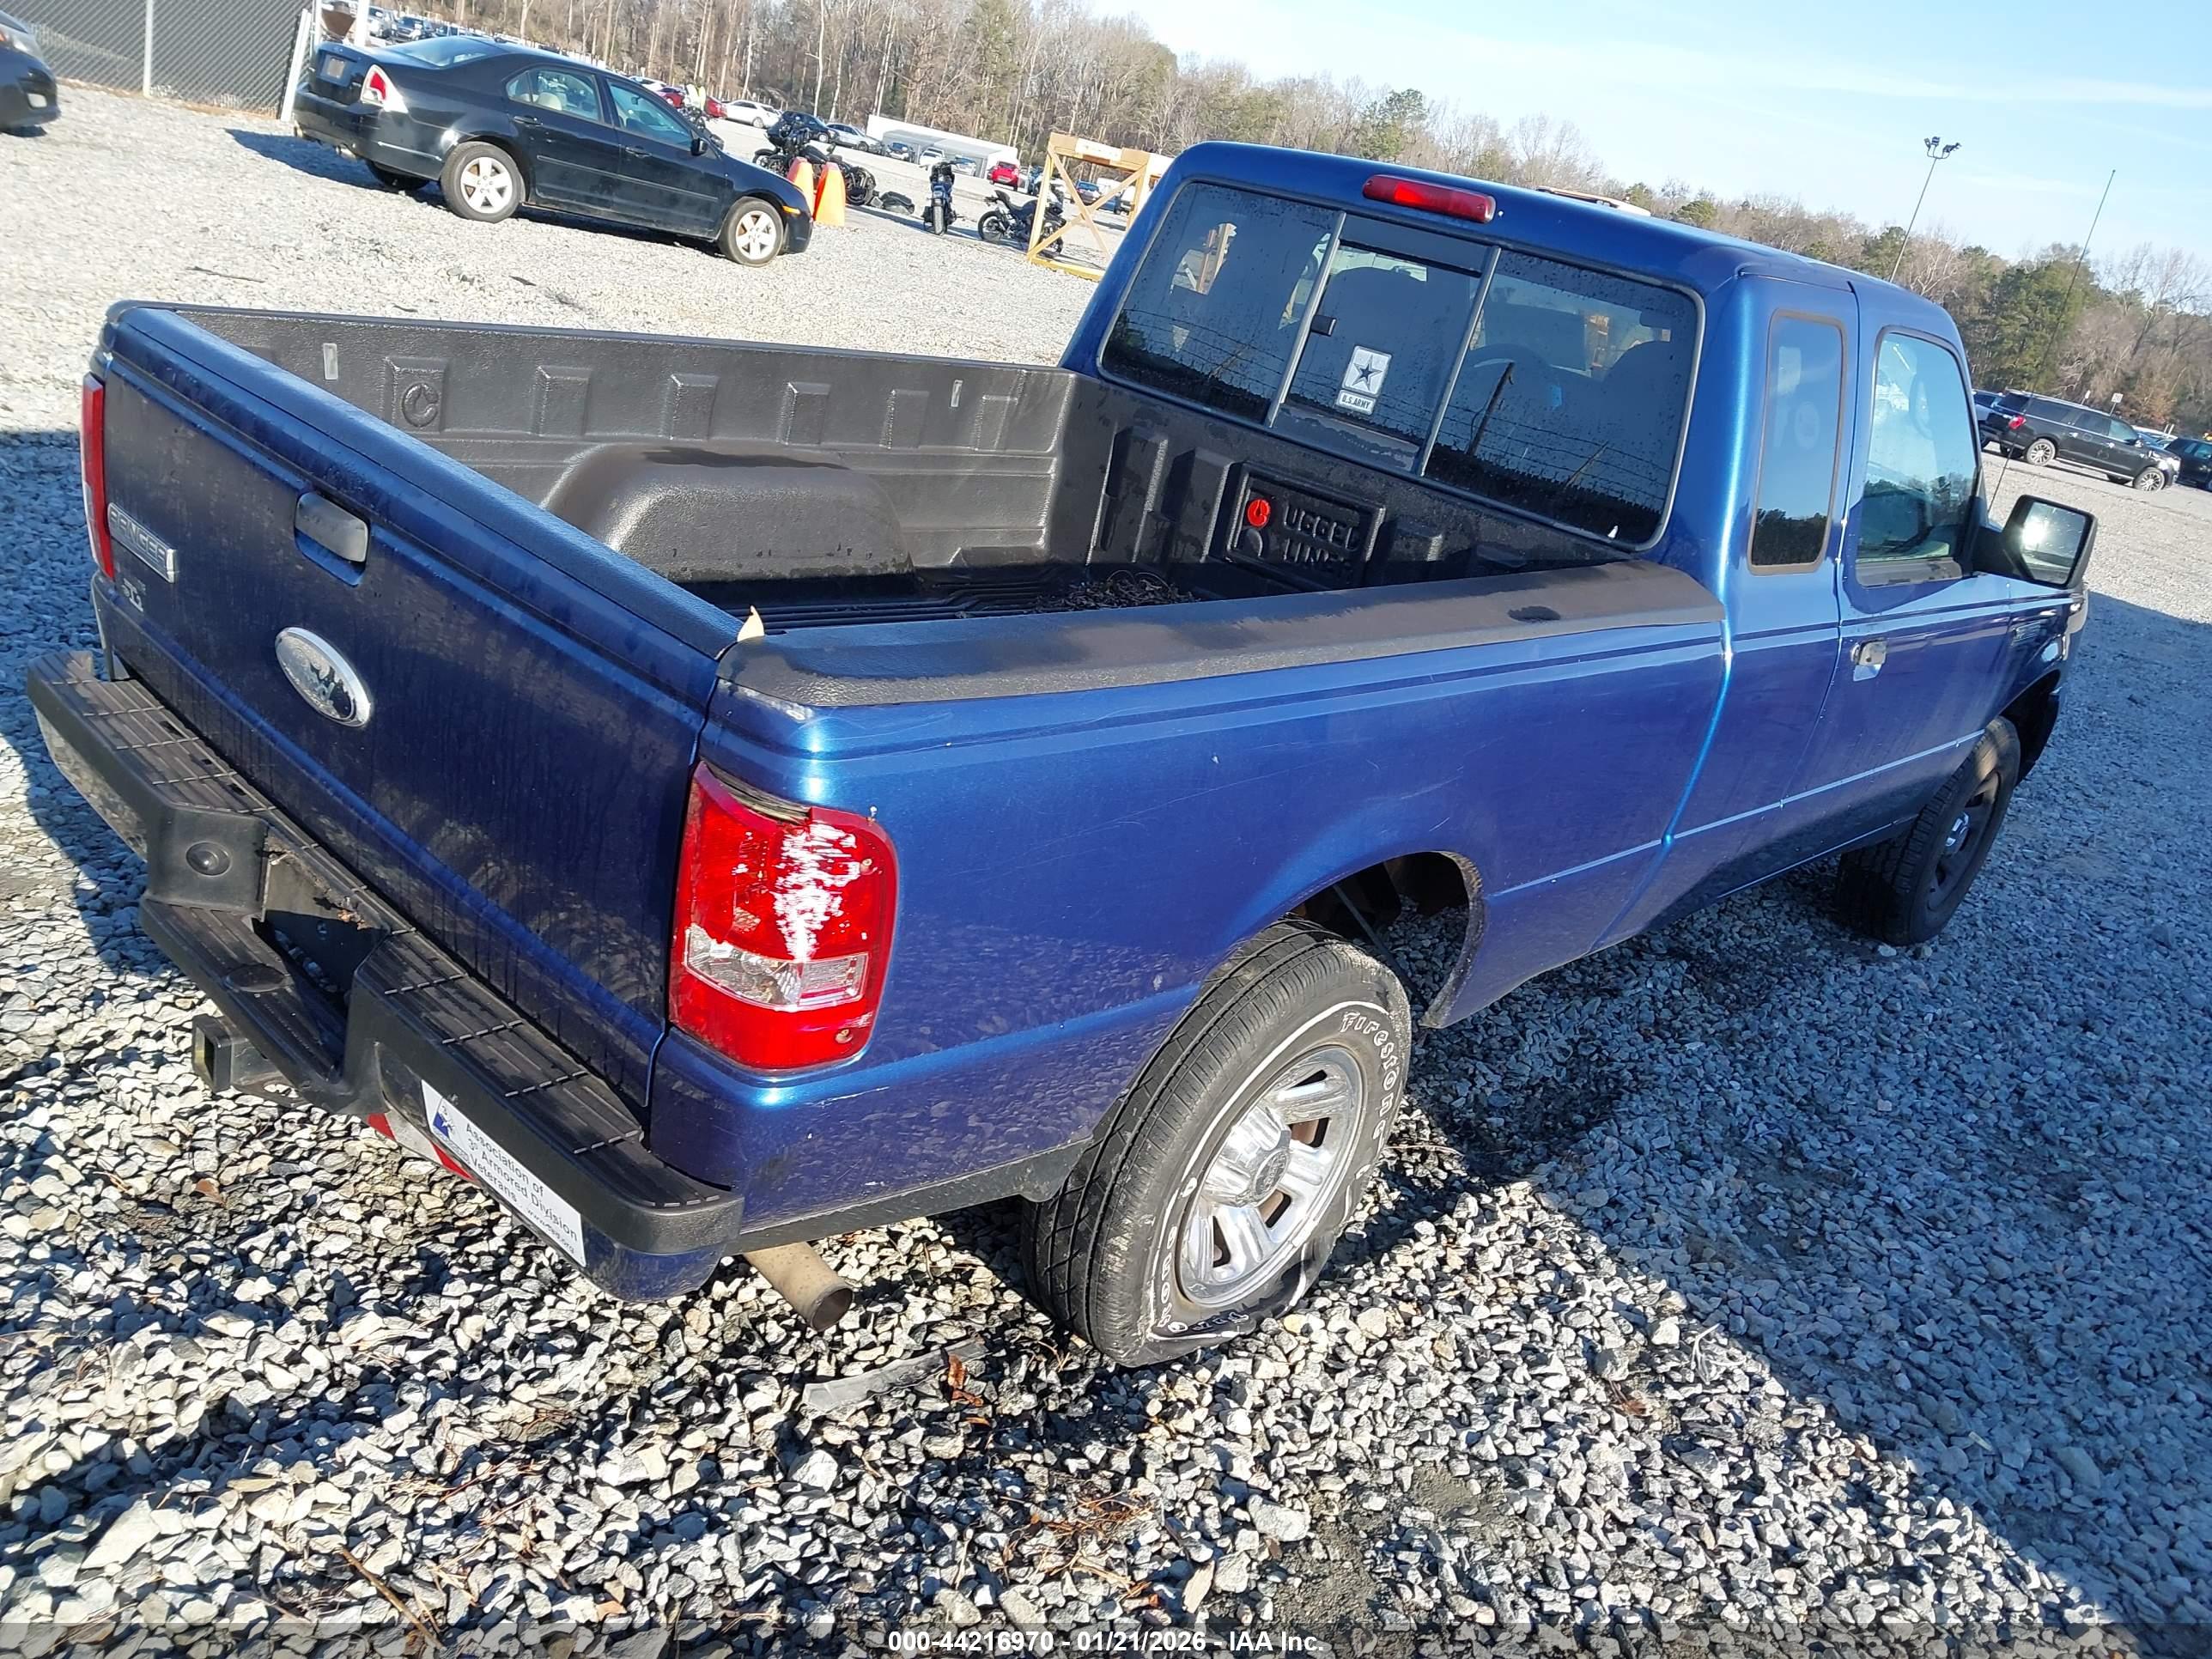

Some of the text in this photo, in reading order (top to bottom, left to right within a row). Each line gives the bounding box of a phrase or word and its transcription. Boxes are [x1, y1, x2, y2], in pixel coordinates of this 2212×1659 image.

[1352, 398, 1371, 410] ARMY
[1340, 1012, 1400, 1149] Firestone
[466, 1123, 529, 1183] Association
[532, 1182, 544, 1197] of
[471, 1153, 517, 1202] Veterans
[481, 1151, 528, 1198] Armored
[531, 1192, 578, 1242] Division
